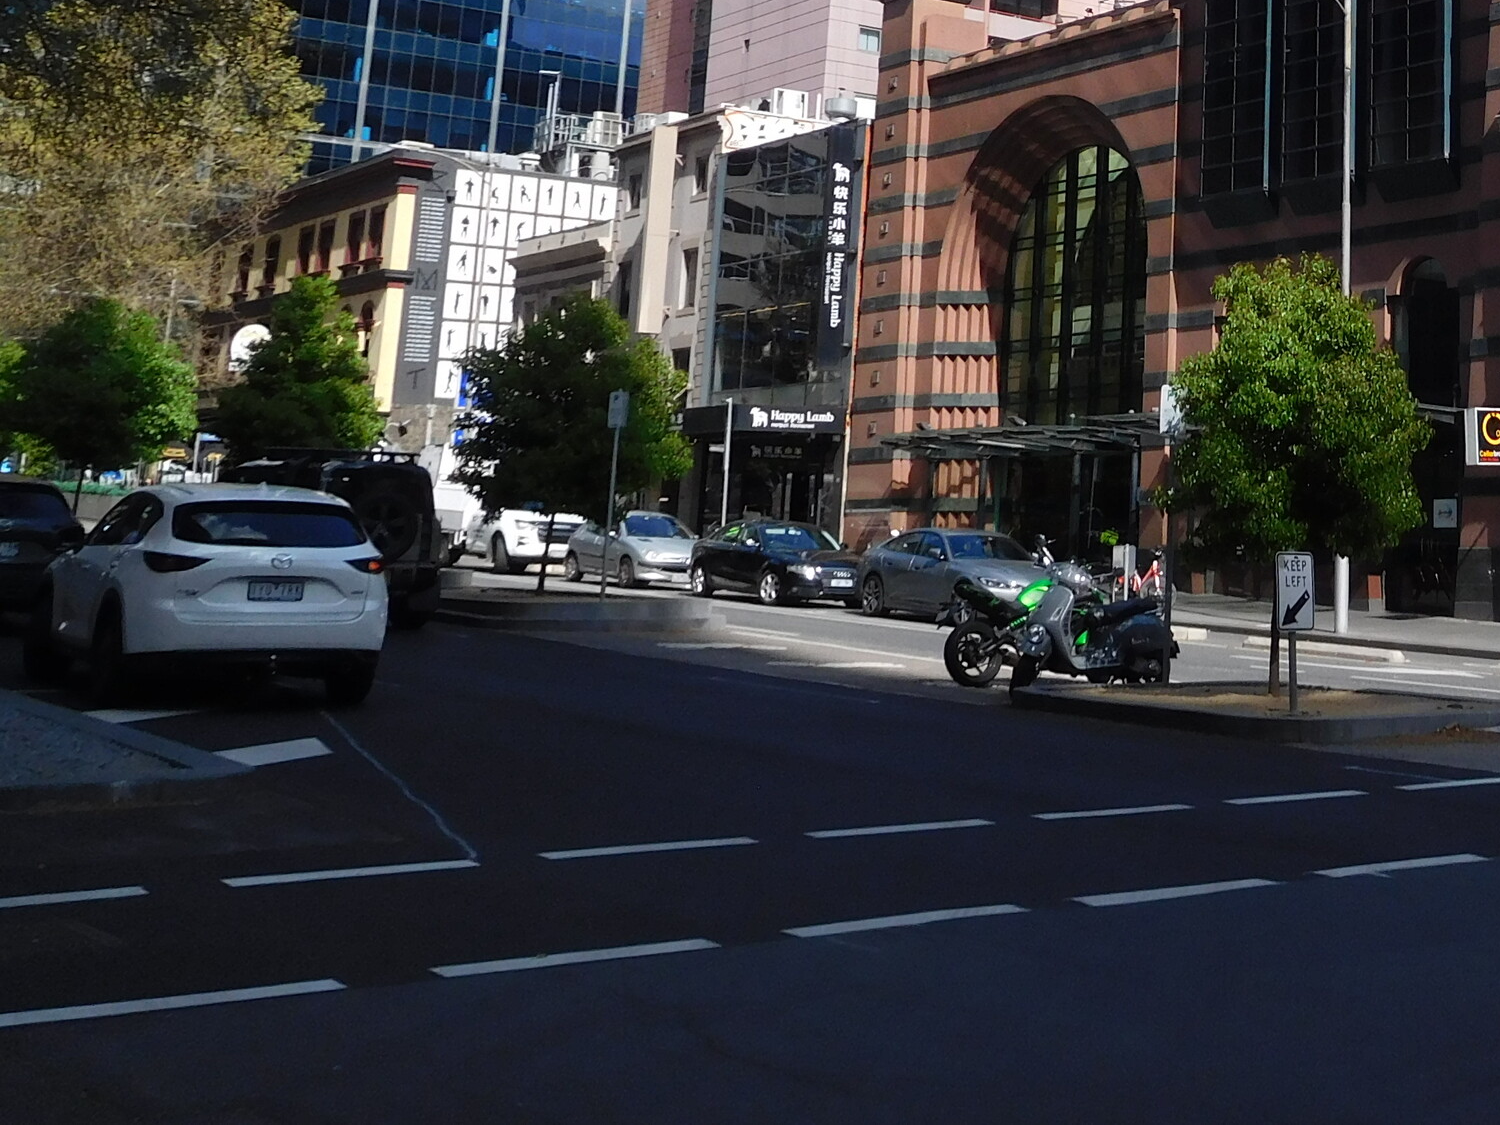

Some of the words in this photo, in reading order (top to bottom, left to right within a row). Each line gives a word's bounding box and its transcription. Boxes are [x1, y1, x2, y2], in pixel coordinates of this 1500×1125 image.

[831, 185, 849, 246] 快乐小羊
[830, 252, 845, 292] Happy
[830, 295, 843, 328] Lamb
[770, 410, 805, 424] Happy
[806, 411, 835, 423] Lamb
[1283, 560, 1307, 571] KEEP
[1285, 576, 1306, 587] LEFT
